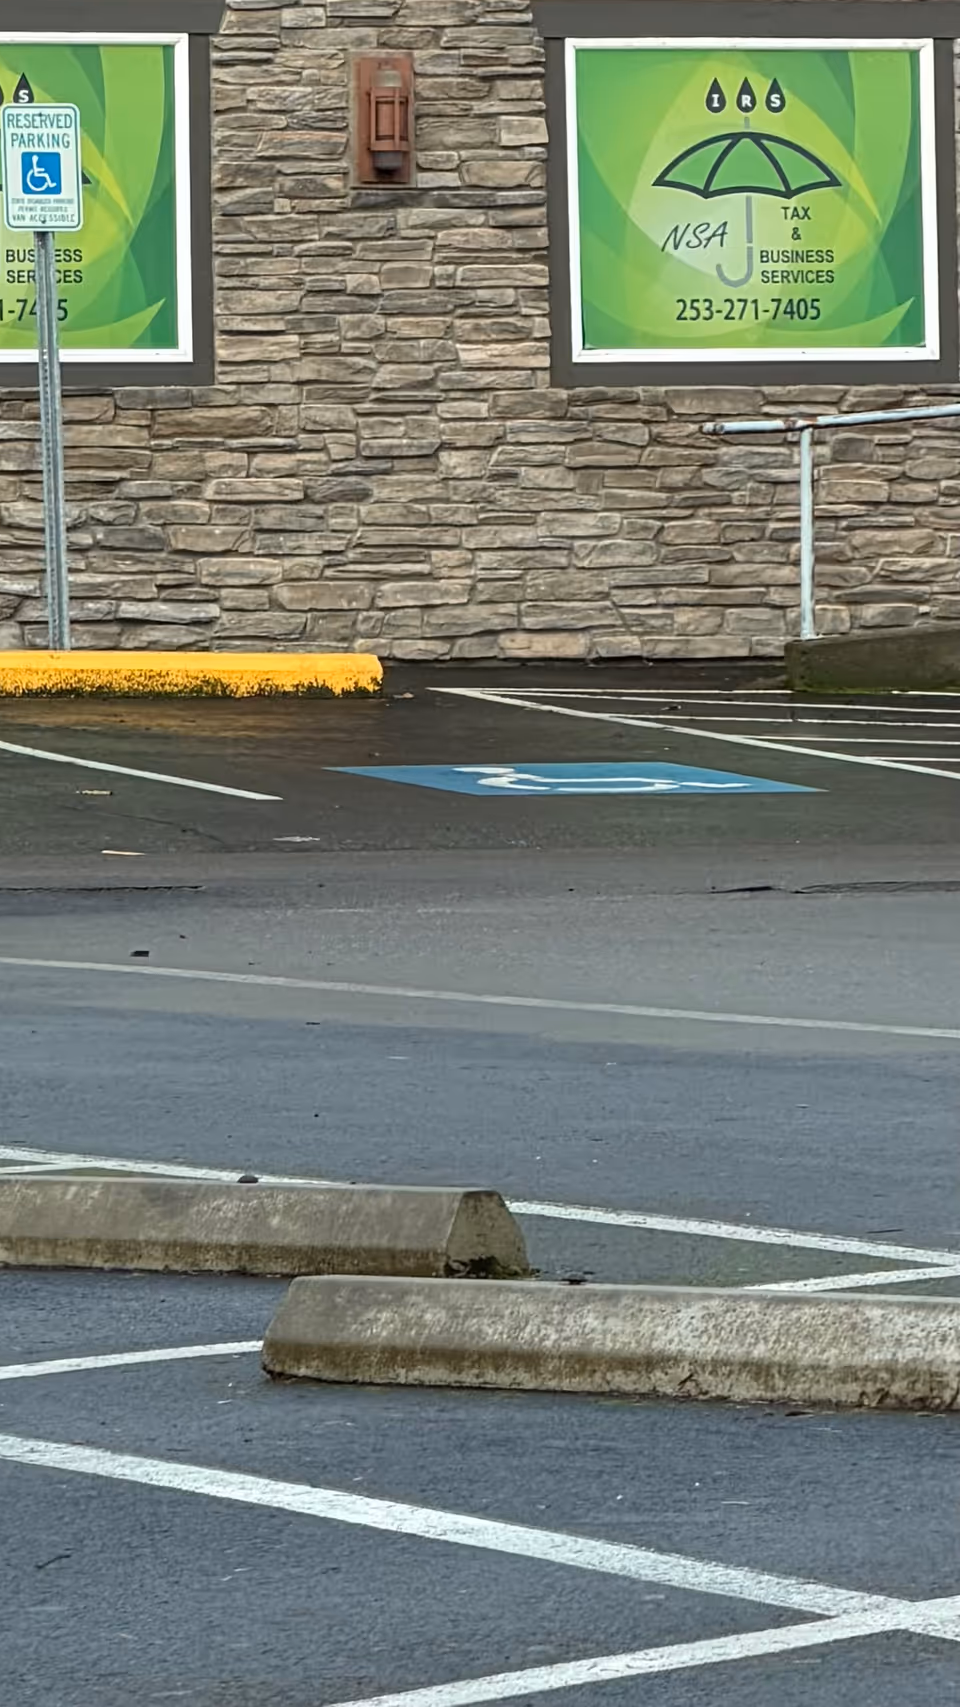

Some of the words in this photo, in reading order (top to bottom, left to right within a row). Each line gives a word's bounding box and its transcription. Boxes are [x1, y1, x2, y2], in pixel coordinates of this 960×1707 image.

[7, 113, 73, 129] RESERVED
[10, 133, 71, 149] PARKING
[781, 206, 812, 220] TAX
[661, 221, 729, 252] NSA
[791, 227, 802, 241] &
[6, 249, 83, 263] BUSESS
[760, 250, 835, 264] BUSINESS
[6, 270, 83, 284] SERCES
[761, 270, 835, 284] SERVICES
[676, 298, 821, 321] 253-271-7405
